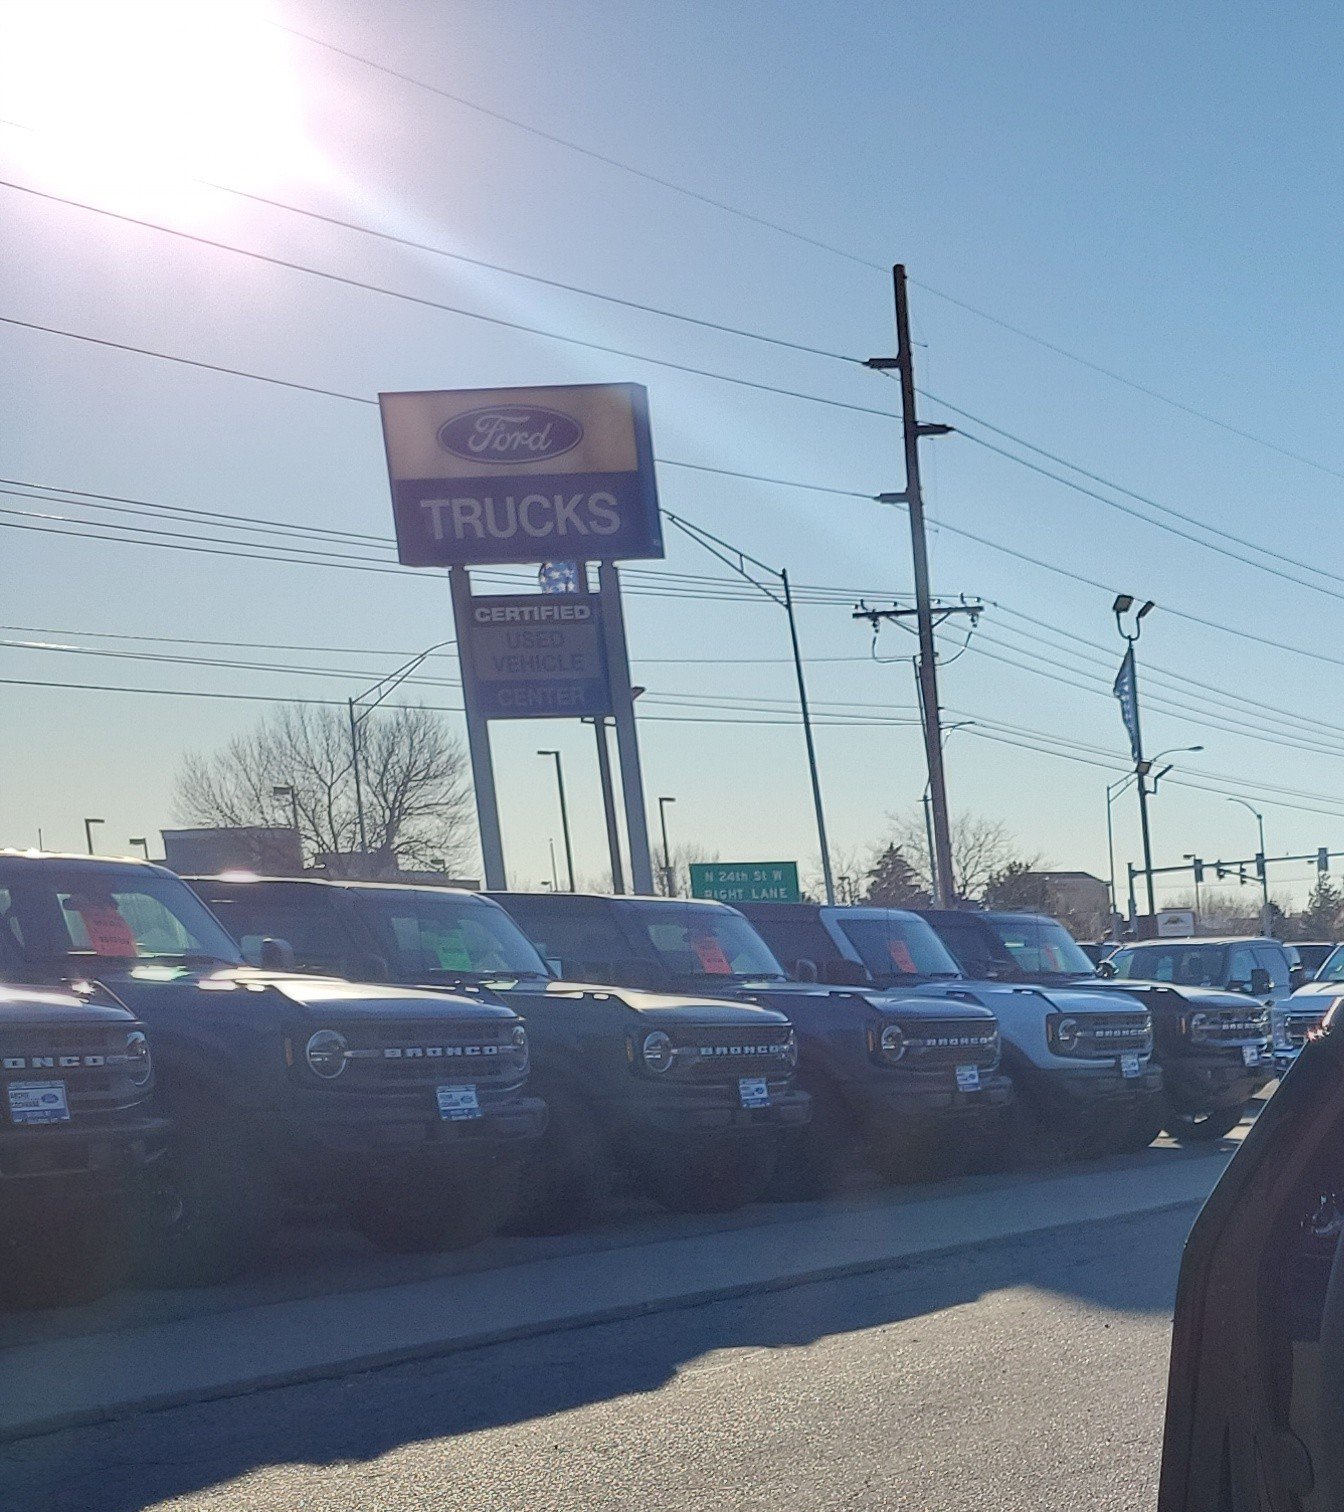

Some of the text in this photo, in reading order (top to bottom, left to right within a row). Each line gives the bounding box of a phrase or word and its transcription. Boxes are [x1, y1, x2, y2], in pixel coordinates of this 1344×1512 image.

[468, 415, 553, 453] Ford
[420, 492, 621, 541] TRUCKS
[474, 604, 591, 623] CERTIFIED
[507, 629, 565, 650] USED
[492, 653, 585, 674] VEHICLE
[496, 685, 586, 707] CENTER
[718, 870, 748, 883] 24th
[753, 870, 767, 882] St
[703, 887, 788, 900] RIGHT LANE
[926, 1036, 988, 1046] BRONCO
[384, 1046, 498, 1059] BRONCO
[700, 1044, 779, 1055] BRONCO
[2, 1055, 105, 1069] ONCO
